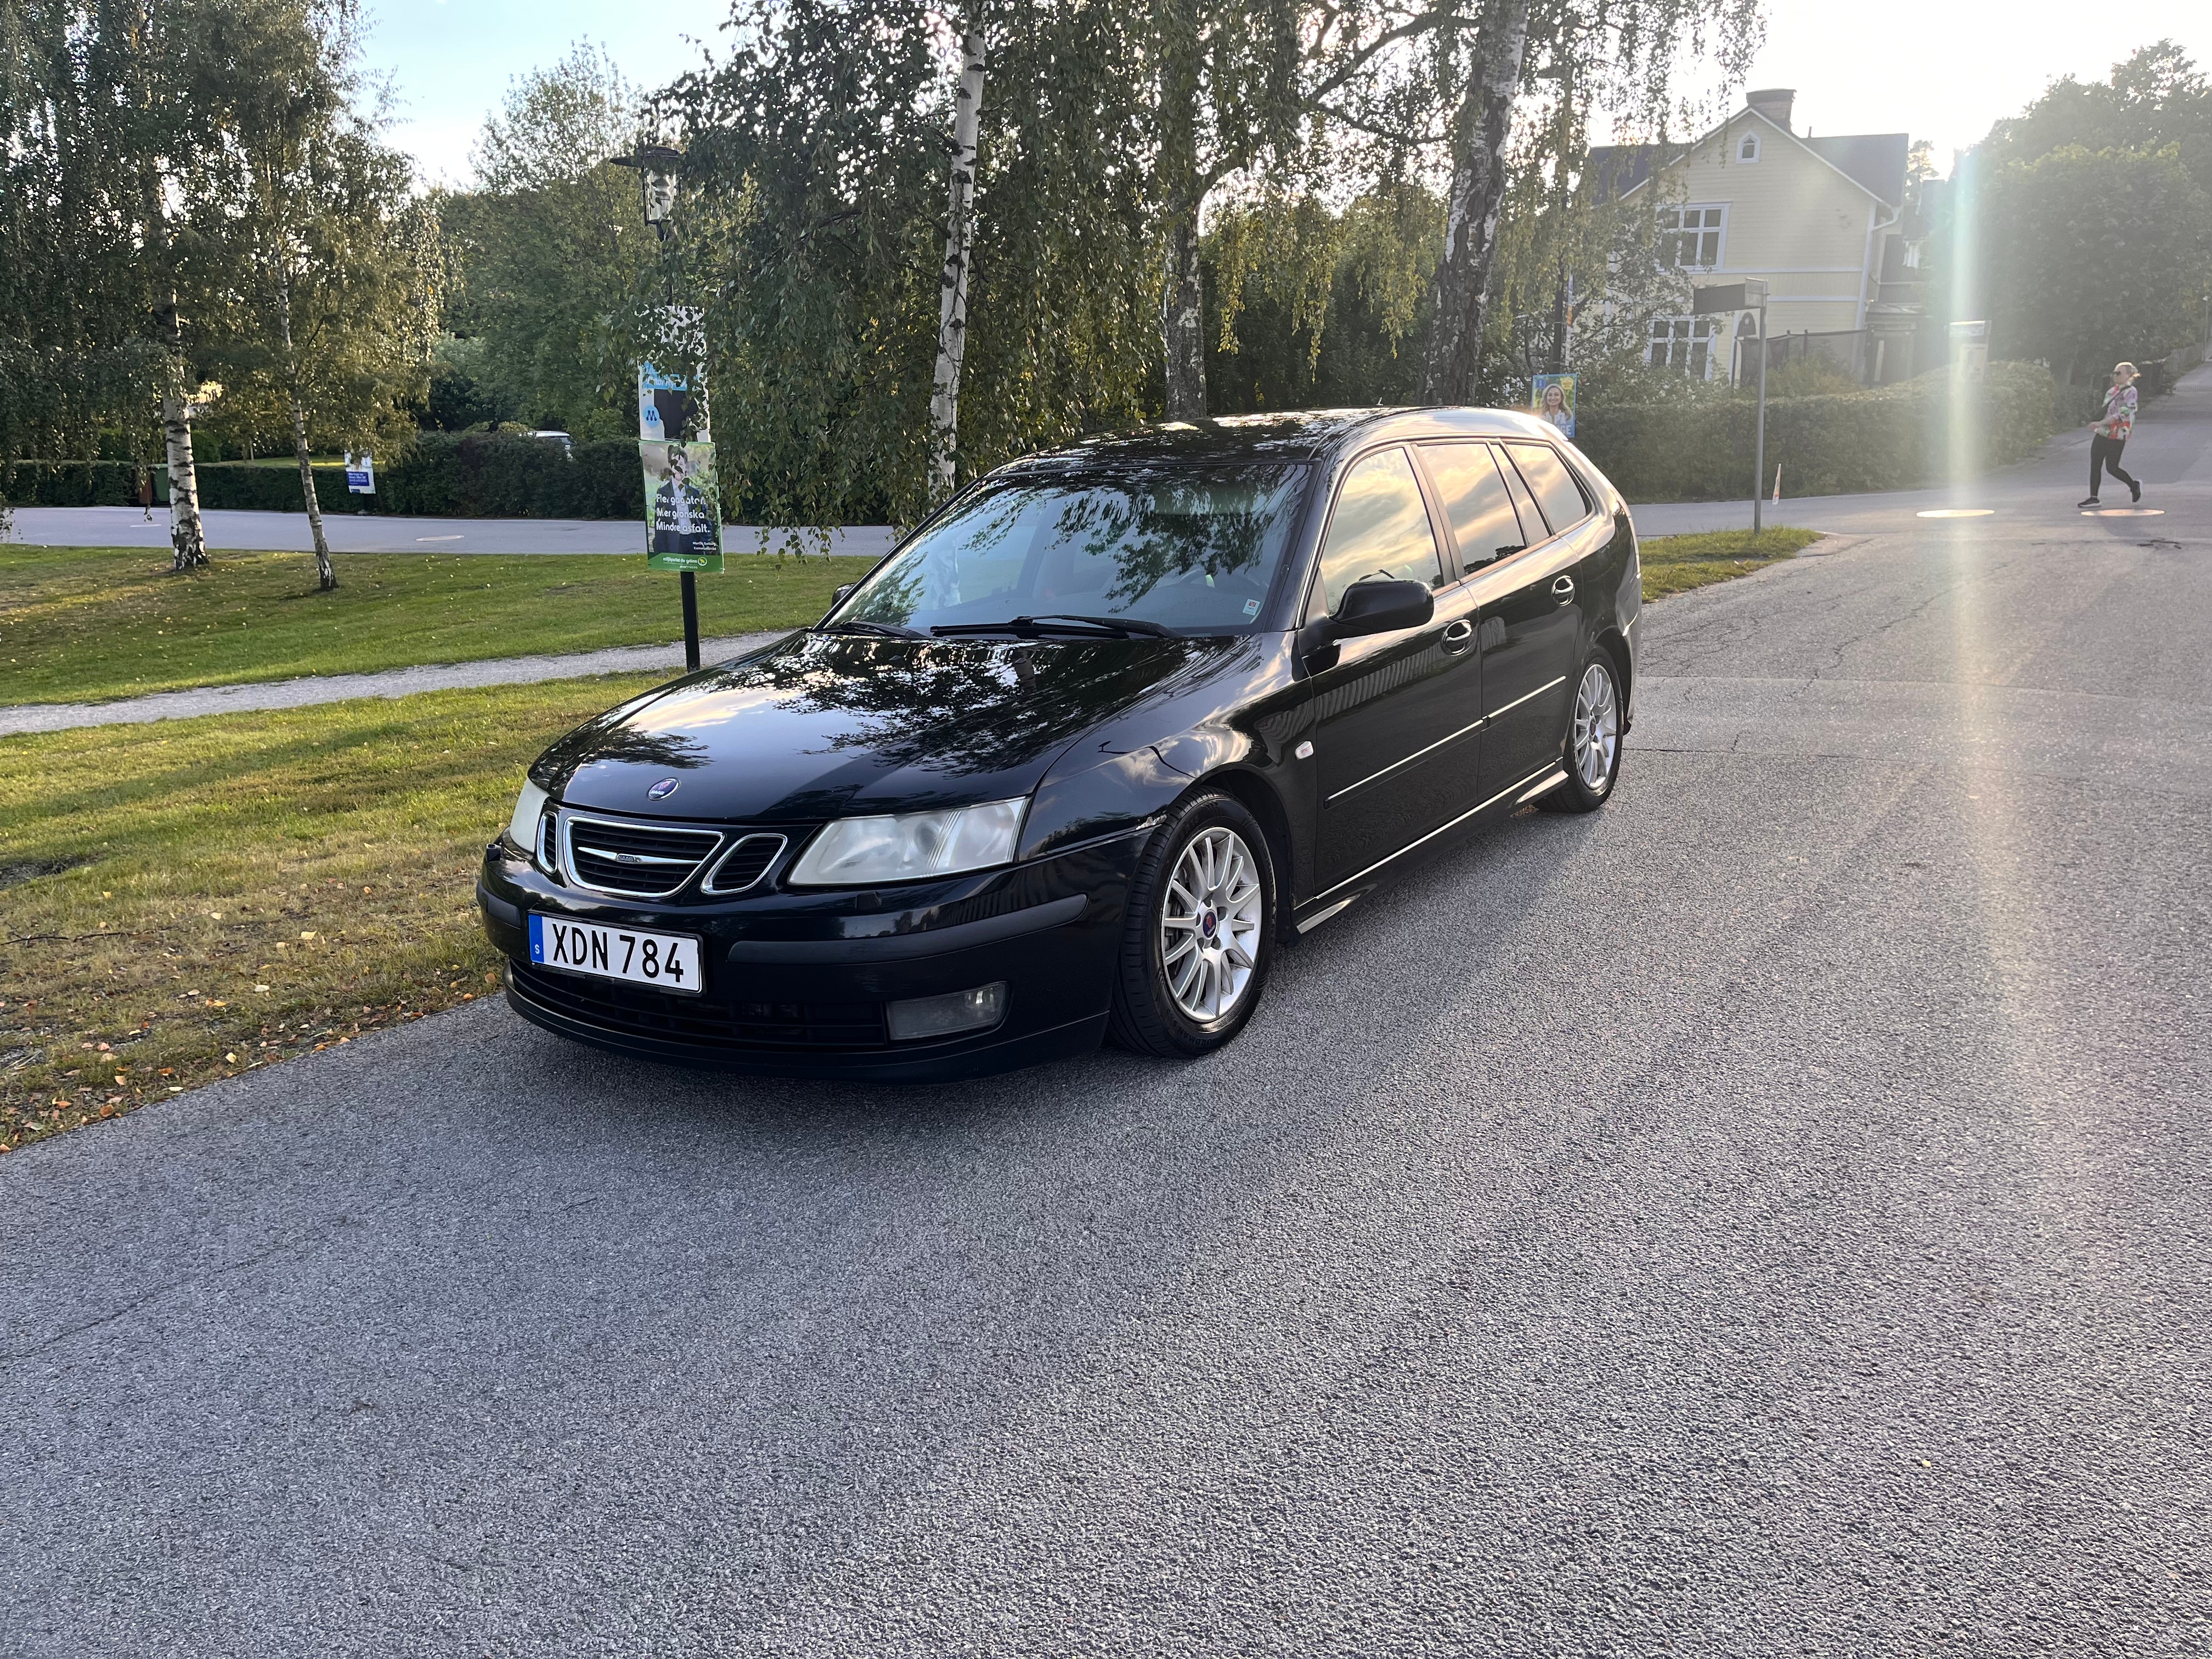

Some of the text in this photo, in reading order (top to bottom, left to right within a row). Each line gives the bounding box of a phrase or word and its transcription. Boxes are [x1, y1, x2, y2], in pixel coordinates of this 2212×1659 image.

[656, 493, 669, 503] Fler
[657, 507, 671, 517] Mer
[656, 521, 710, 533] Mindre asfalt.
[534, 944, 540, 954] S
[552, 923, 684, 983] XDN 784
